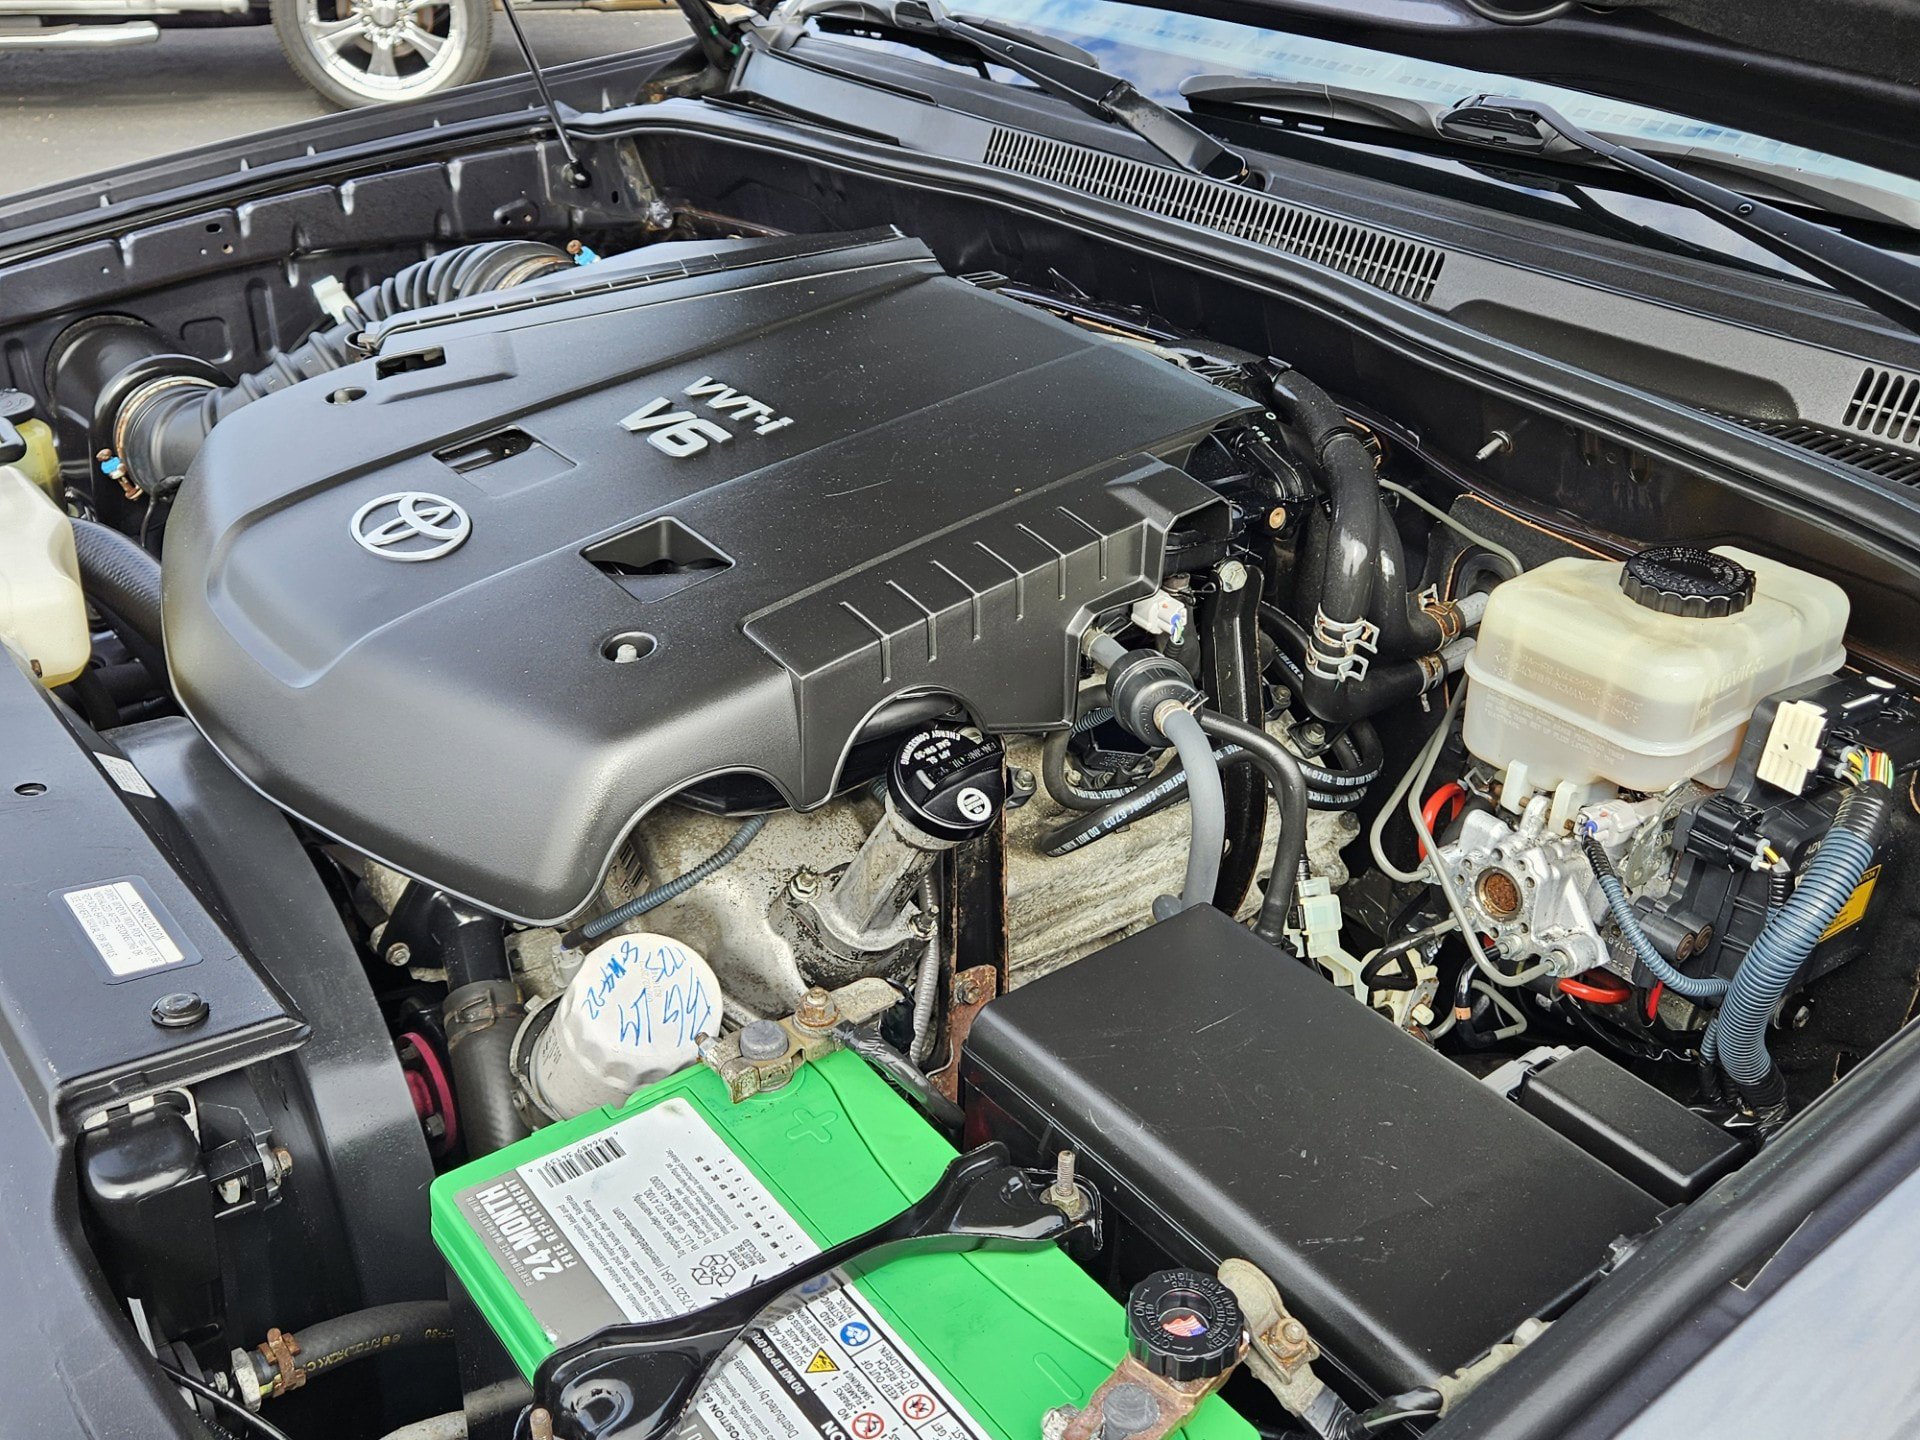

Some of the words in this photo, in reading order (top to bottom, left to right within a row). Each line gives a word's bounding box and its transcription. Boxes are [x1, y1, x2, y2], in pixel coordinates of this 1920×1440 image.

[681, 375, 795, 436] VVT-i
[617, 396, 733, 458] V6
[465, 1195, 481, 1212] WITH
[504, 1179, 557, 1242] REPLACEMENT
[476, 1212, 503, 1243] WARRANTY
[476, 1184, 563, 1280] 24-MONTH
[552, 1242, 577, 1268] FREE
[734, 1243, 745, 1252] BE
[741, 1238, 766, 1264] RECYCLED
[499, 1243, 536, 1286] PERFORMANCE
[727, 1248, 749, 1270] BATTERY
[740, 1251, 756, 1266] MUST
[660, 1269, 677, 1285] USA
[1162, 1272, 1194, 1282] TIGHT
[1202, 1278, 1225, 1295] AND
[670, 1282, 692, 1305] 75251
[792, 1307, 811, 1325] BURN
[835, 1297, 855, 1318] TIONS.
[819, 1311, 837, 1328] READ
[766, 1323, 781, 1336] ACI
[784, 1327, 802, 1346] CAUSE
[790, 1319, 819, 1348] BLINDNESS
[807, 1323, 828, 1344] SEVERE
[750, 1332, 767, 1348] OPE
[1207, 1330, 1230, 1349] KEEP
[761, 1345, 775, 1358] OR
[775, 1334, 806, 1366] SULFURIC
[800, 1344, 812, 1357] CAN
[770, 1357, 784, 1370] TIP
[860, 1360, 873, 1370] OF
[875, 1359, 898, 1381] REACH
[880, 1344, 909, 1377] CHILDREN.
[733, 1359, 762, 1392] Interstate
[778, 1367, 796, 1383] NOT
[868, 1368, 885, 1383] OUT
[901, 1374, 919, 1389] OF
[707, 1381, 730, 1405] chemica
[757, 1389, 769, 1401] by
[790, 1381, 805, 1394] DO
[841, 1382, 863, 1405] FLAMES
[845, 1372, 872, 1400] SMOKING
[881, 1383, 899, 1400] KEEP
[894, 1380, 909, 1395] THE
[737, 1398, 752, 1414] other
[832, 1387, 855, 1410] SPARKS
[761, 1398, 798, 1440] Distributed
[837, 1408, 851, 1420] NO
